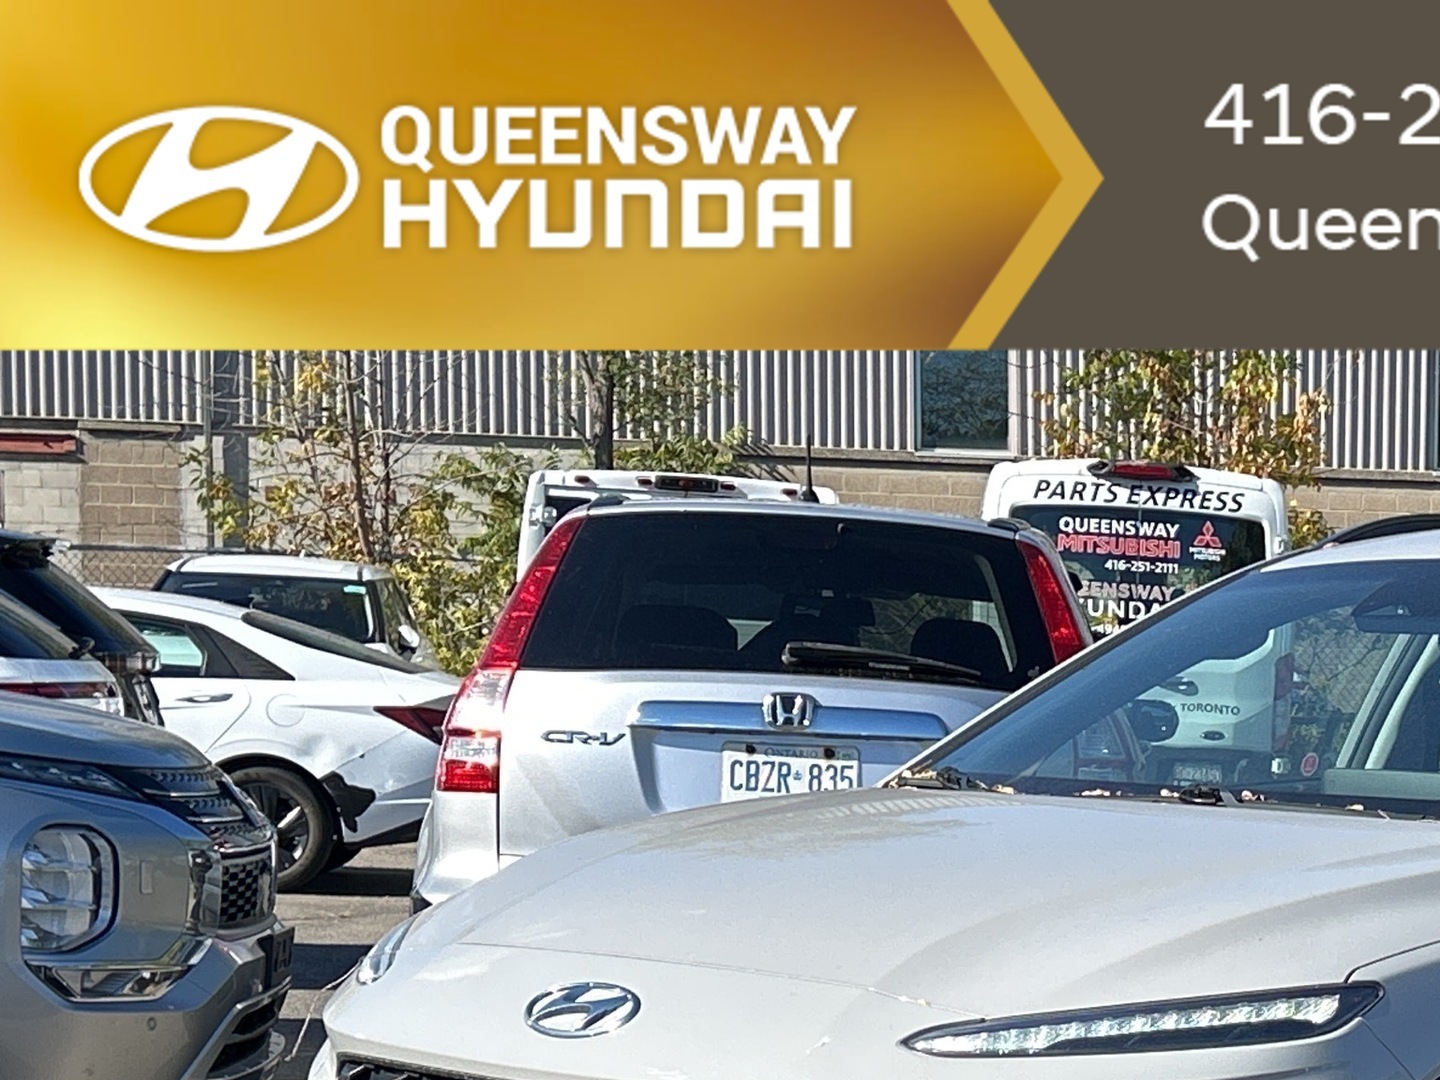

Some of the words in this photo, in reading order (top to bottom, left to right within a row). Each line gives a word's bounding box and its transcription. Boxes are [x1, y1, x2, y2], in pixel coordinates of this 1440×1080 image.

[1033, 479, 1119, 504] PARTS
[1126, 484, 1245, 512] EXPRESS
[1058, 515, 1181, 538] QUEENSWAY
[1057, 533, 1181, 559] MITSUBISHI
[1103, 558, 1179, 574] 416-251-2111
[1078, 580, 1176, 602] EENSWAY
[1078, 598, 1162, 619] UNDA
[1180, 702, 1241, 716] TORONTO
[541, 729, 627, 746] CR-V
[764, 746, 819, 759] ONTARIO
[729, 759, 792, 794] CBZR
[808, 763, 855, 792] 835
